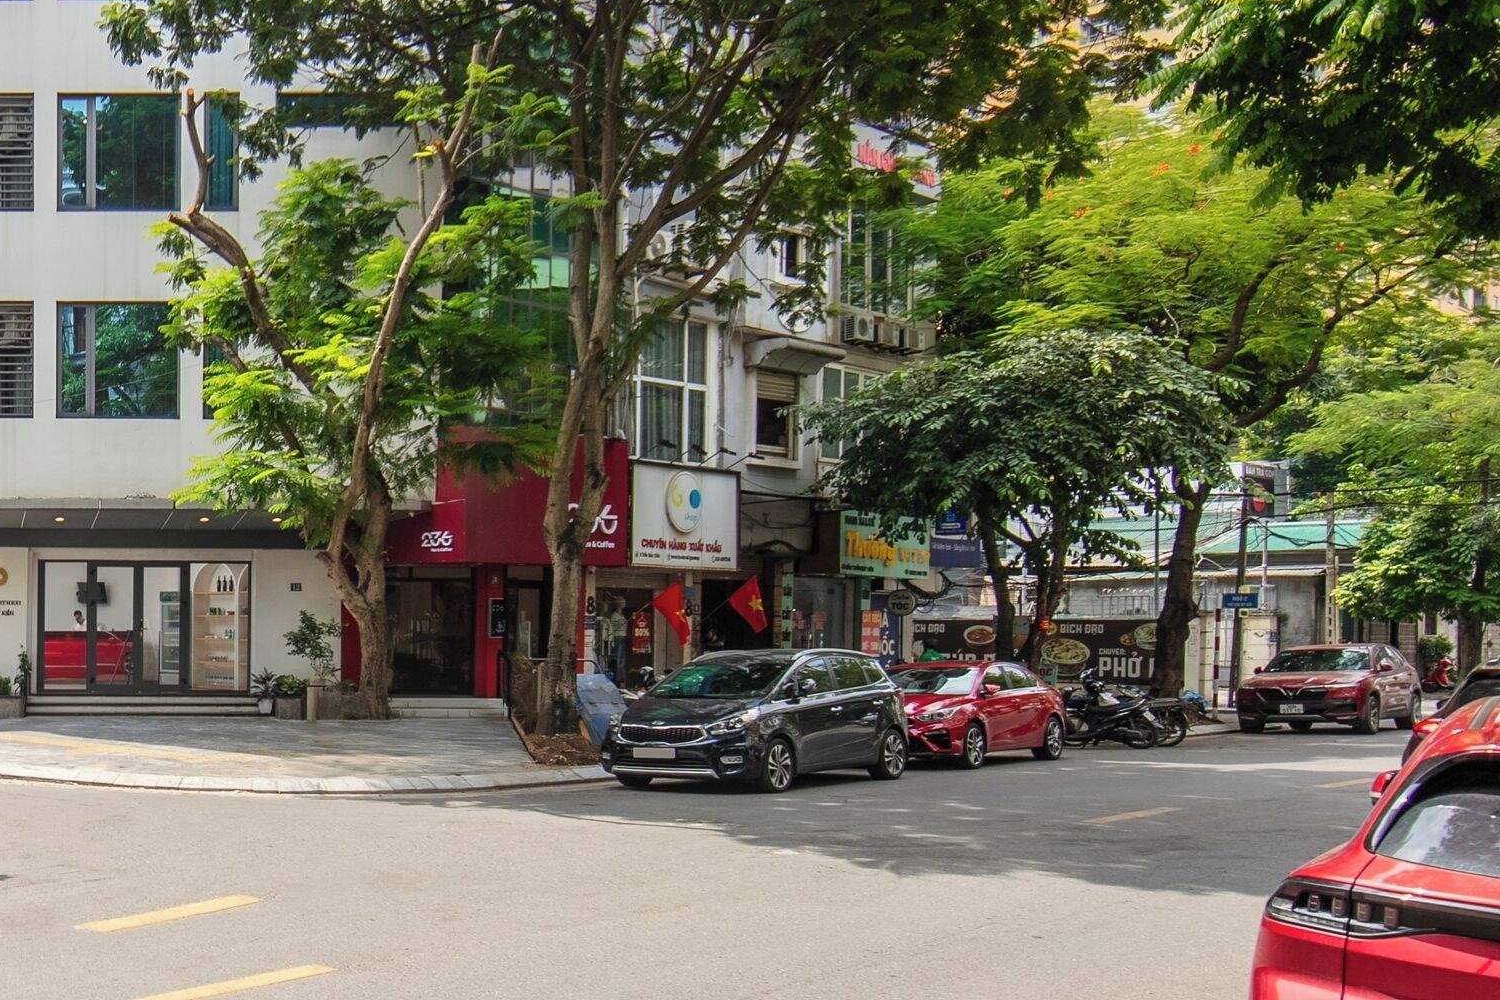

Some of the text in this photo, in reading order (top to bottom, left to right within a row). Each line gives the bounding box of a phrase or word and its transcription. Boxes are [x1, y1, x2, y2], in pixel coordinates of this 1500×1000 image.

[421, 531, 453, 547] 236
[597, 540, 615, 549] Coffee
[641, 538, 722, 553] CHUYÊN HÀNG XUẤT KHẨU
[586, 596, 595, 614] 8
[685, 600, 692, 616] 8
[928, 624, 945, 634] ĐẠO
[1060, 622, 1104, 635] BÍCH ĐẠO
[1099, 651, 1143, 678] PHỞ
